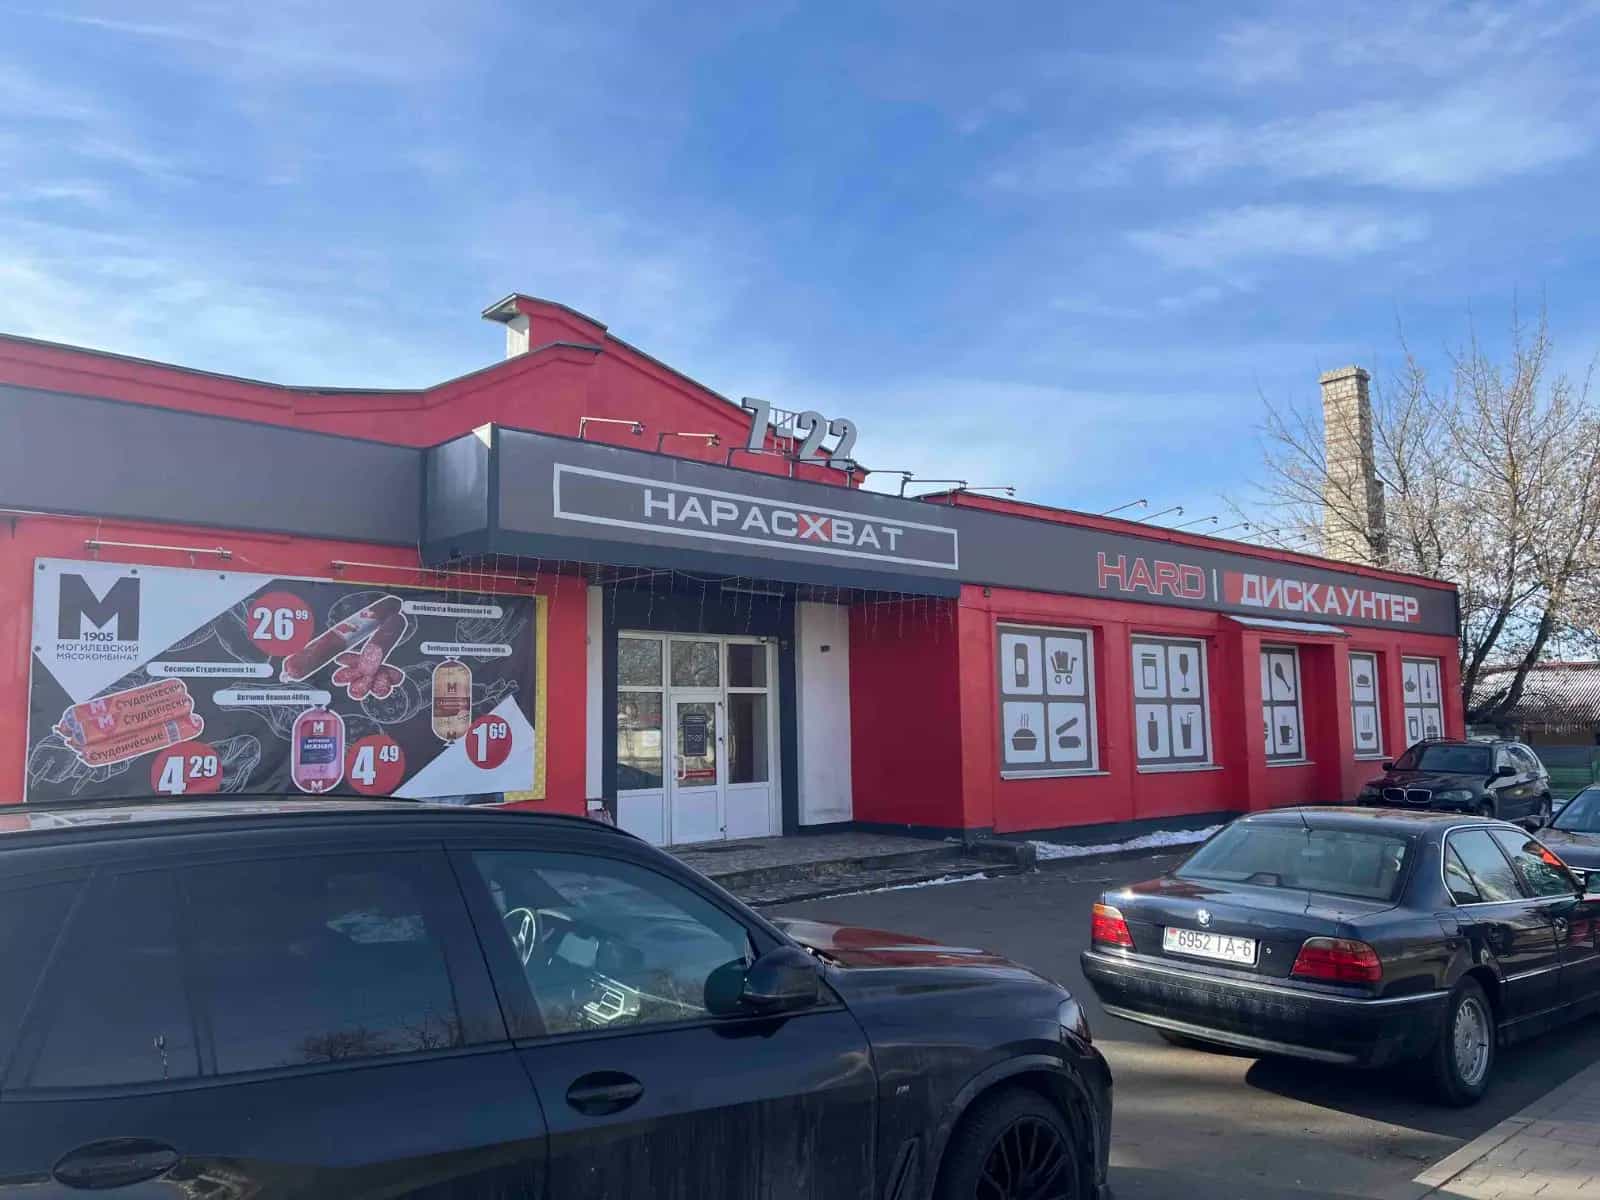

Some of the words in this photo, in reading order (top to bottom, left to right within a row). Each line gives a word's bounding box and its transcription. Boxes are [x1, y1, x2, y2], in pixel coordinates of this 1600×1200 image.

[643, 488, 904, 552] НАРАСХВАТ
[1097, 551, 1207, 600] HARD
[1239, 573, 1420, 622] ДИСКАУНТЕР
[83, 632, 114, 642] 1905
[56, 653, 138, 661] МЯСОКОМБИНАТ
[1178, 931, 1211, 951] 6952
